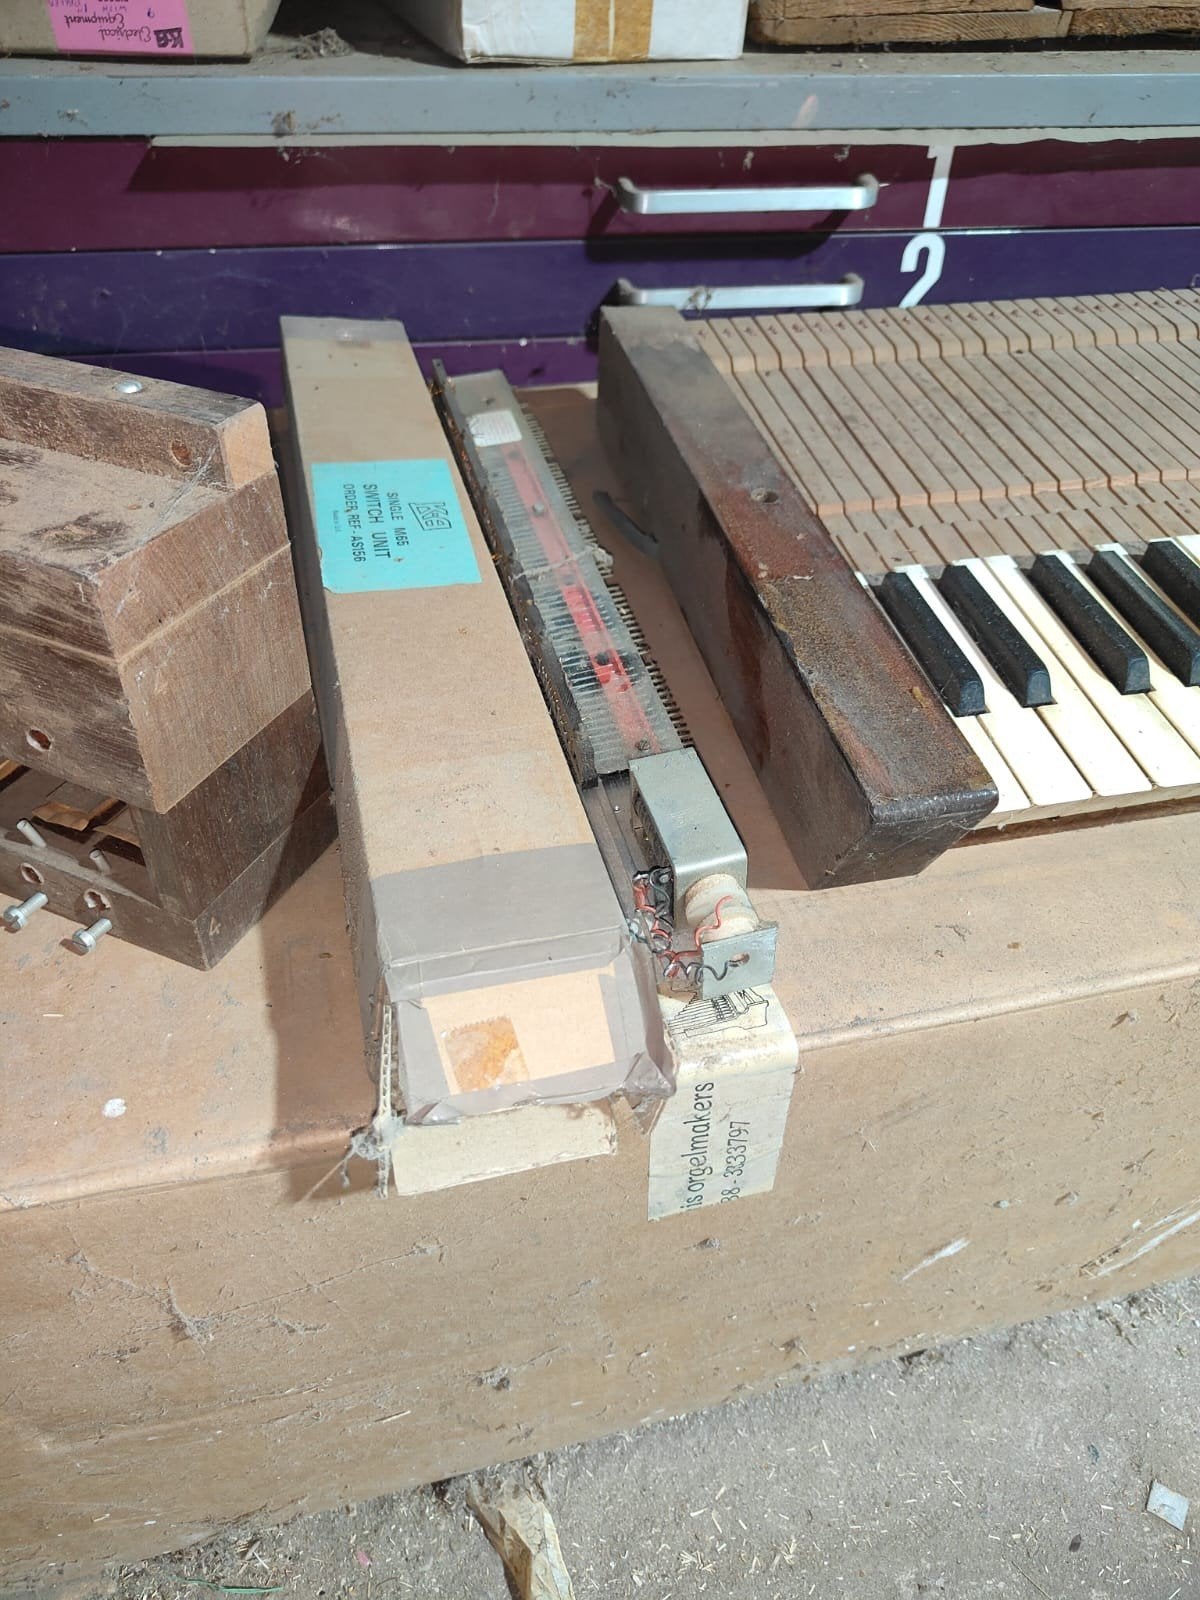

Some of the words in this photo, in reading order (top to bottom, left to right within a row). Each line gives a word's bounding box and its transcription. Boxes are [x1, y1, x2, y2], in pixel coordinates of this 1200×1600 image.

[64, 12, 124, 29] Equipment
[98, 26, 151, 42] Electrical
[923, 145, 955, 228] 1
[899, 233, 945, 309] 2
[343, 483, 358, 512] ORDER
[363, 484, 384, 524] SWITCH
[387, 492, 404, 521] SINGLE
[372, 531, 391, 558] UNIT
[394, 527, 409, 547] M65
[681, 1082, 714, 1192] orgelmakers
